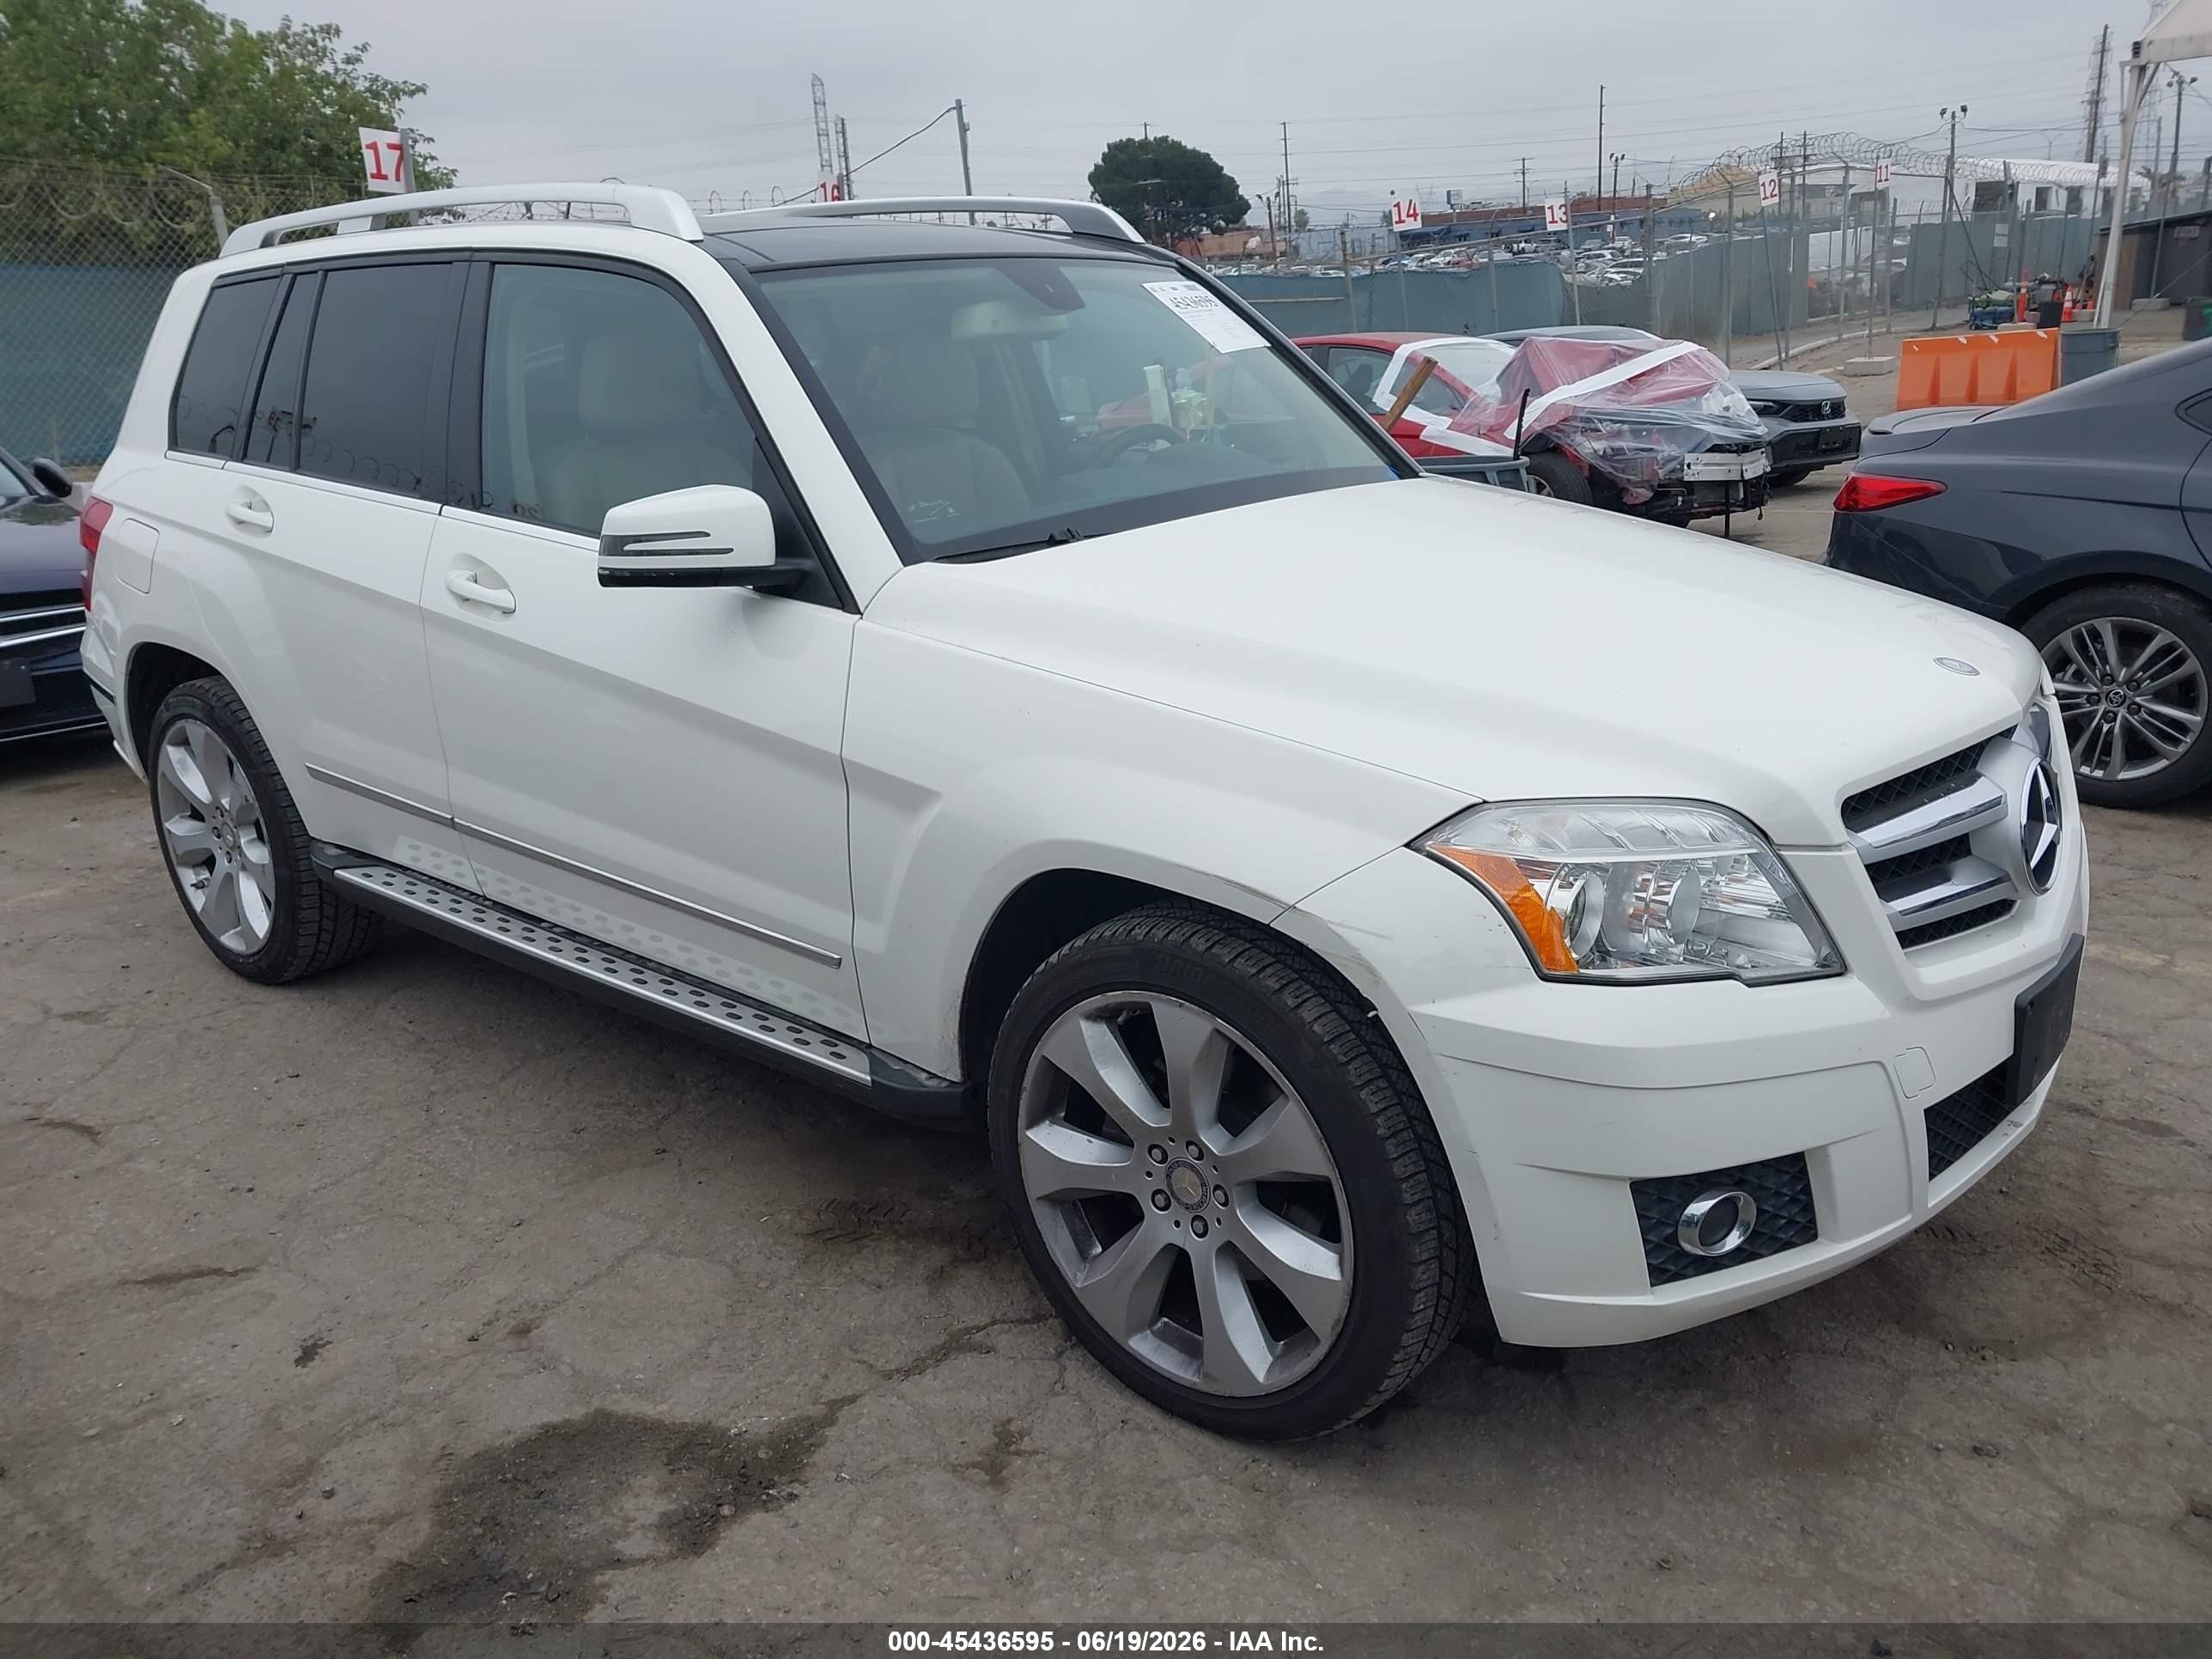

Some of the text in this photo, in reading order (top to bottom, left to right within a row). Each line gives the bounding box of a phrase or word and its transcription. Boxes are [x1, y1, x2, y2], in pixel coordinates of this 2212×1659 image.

[364, 140, 404, 182] 17
[1877, 164, 1890, 183] 11
[1760, 179, 1778, 200] 12
[1392, 198, 1419, 225] 14
[1547, 203, 1568, 225] 13
